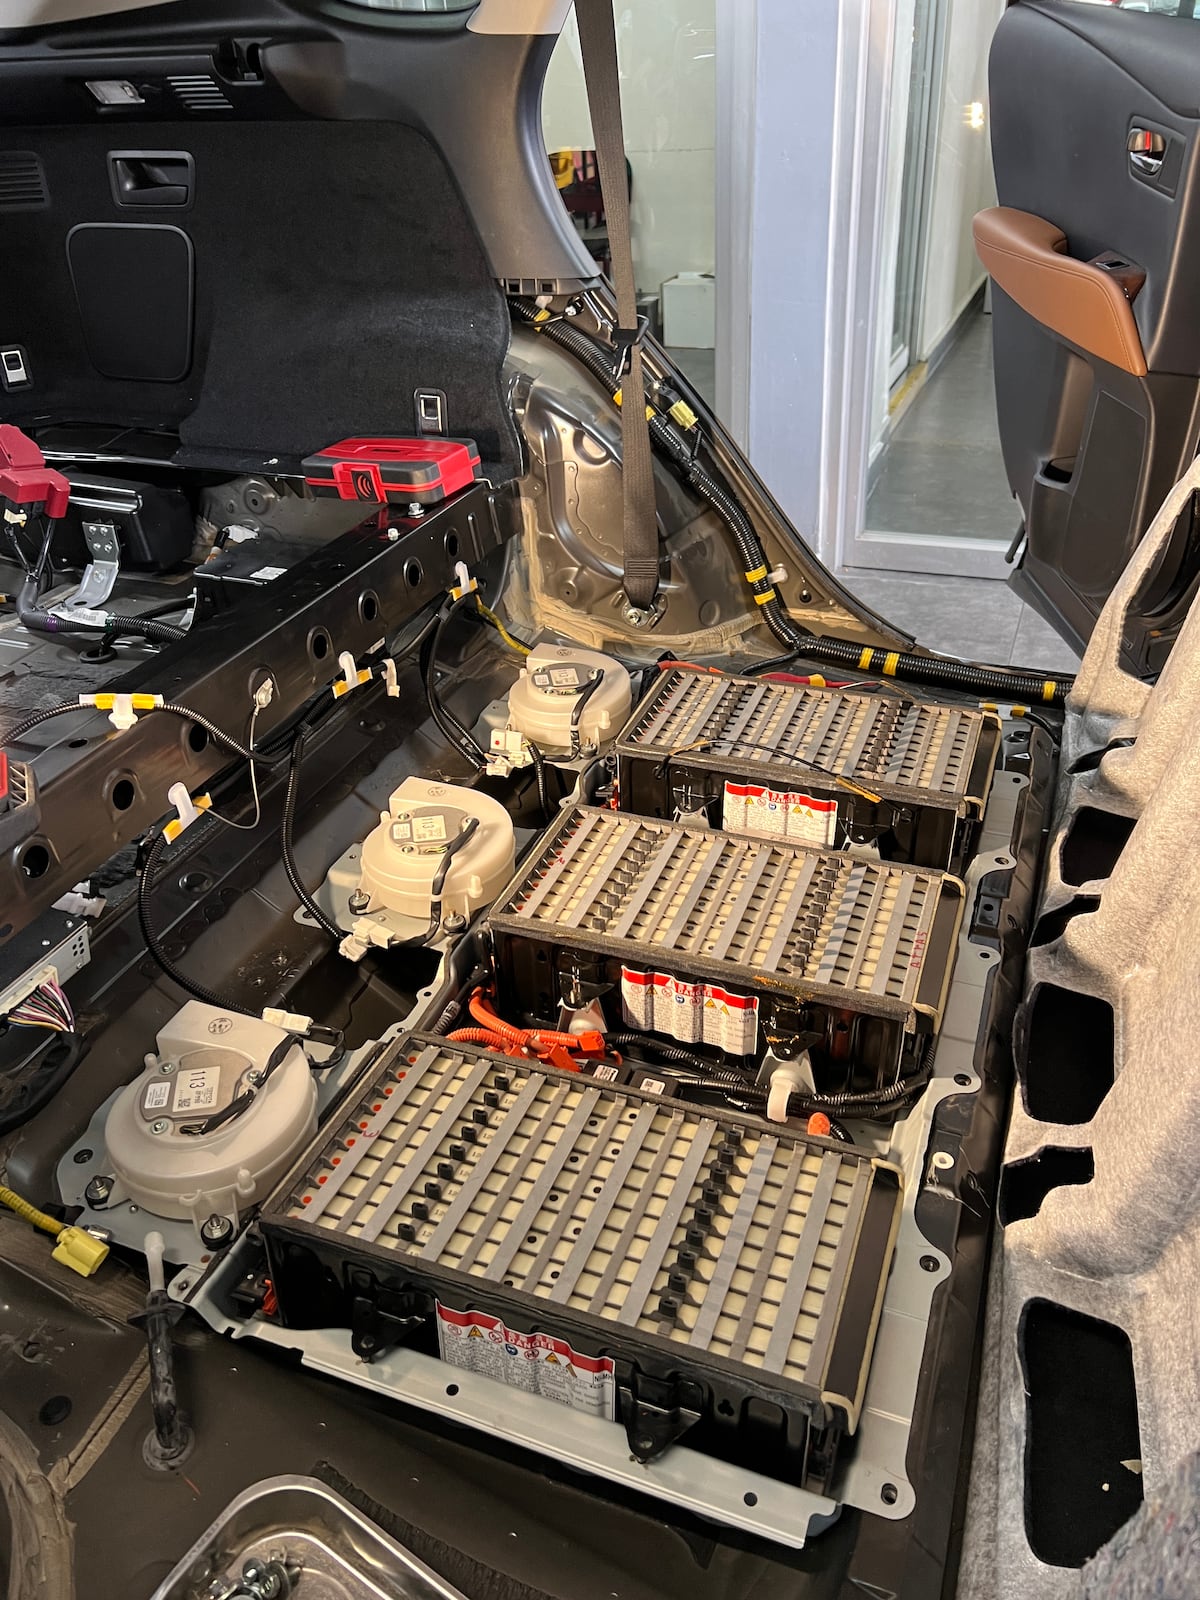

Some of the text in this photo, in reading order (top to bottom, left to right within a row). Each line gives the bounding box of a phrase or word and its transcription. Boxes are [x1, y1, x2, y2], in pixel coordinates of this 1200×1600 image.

[677, 988, 712, 998] DANGER
[189, 1071, 206, 1088] 113
[509, 1336, 554, 1350] DANGER
